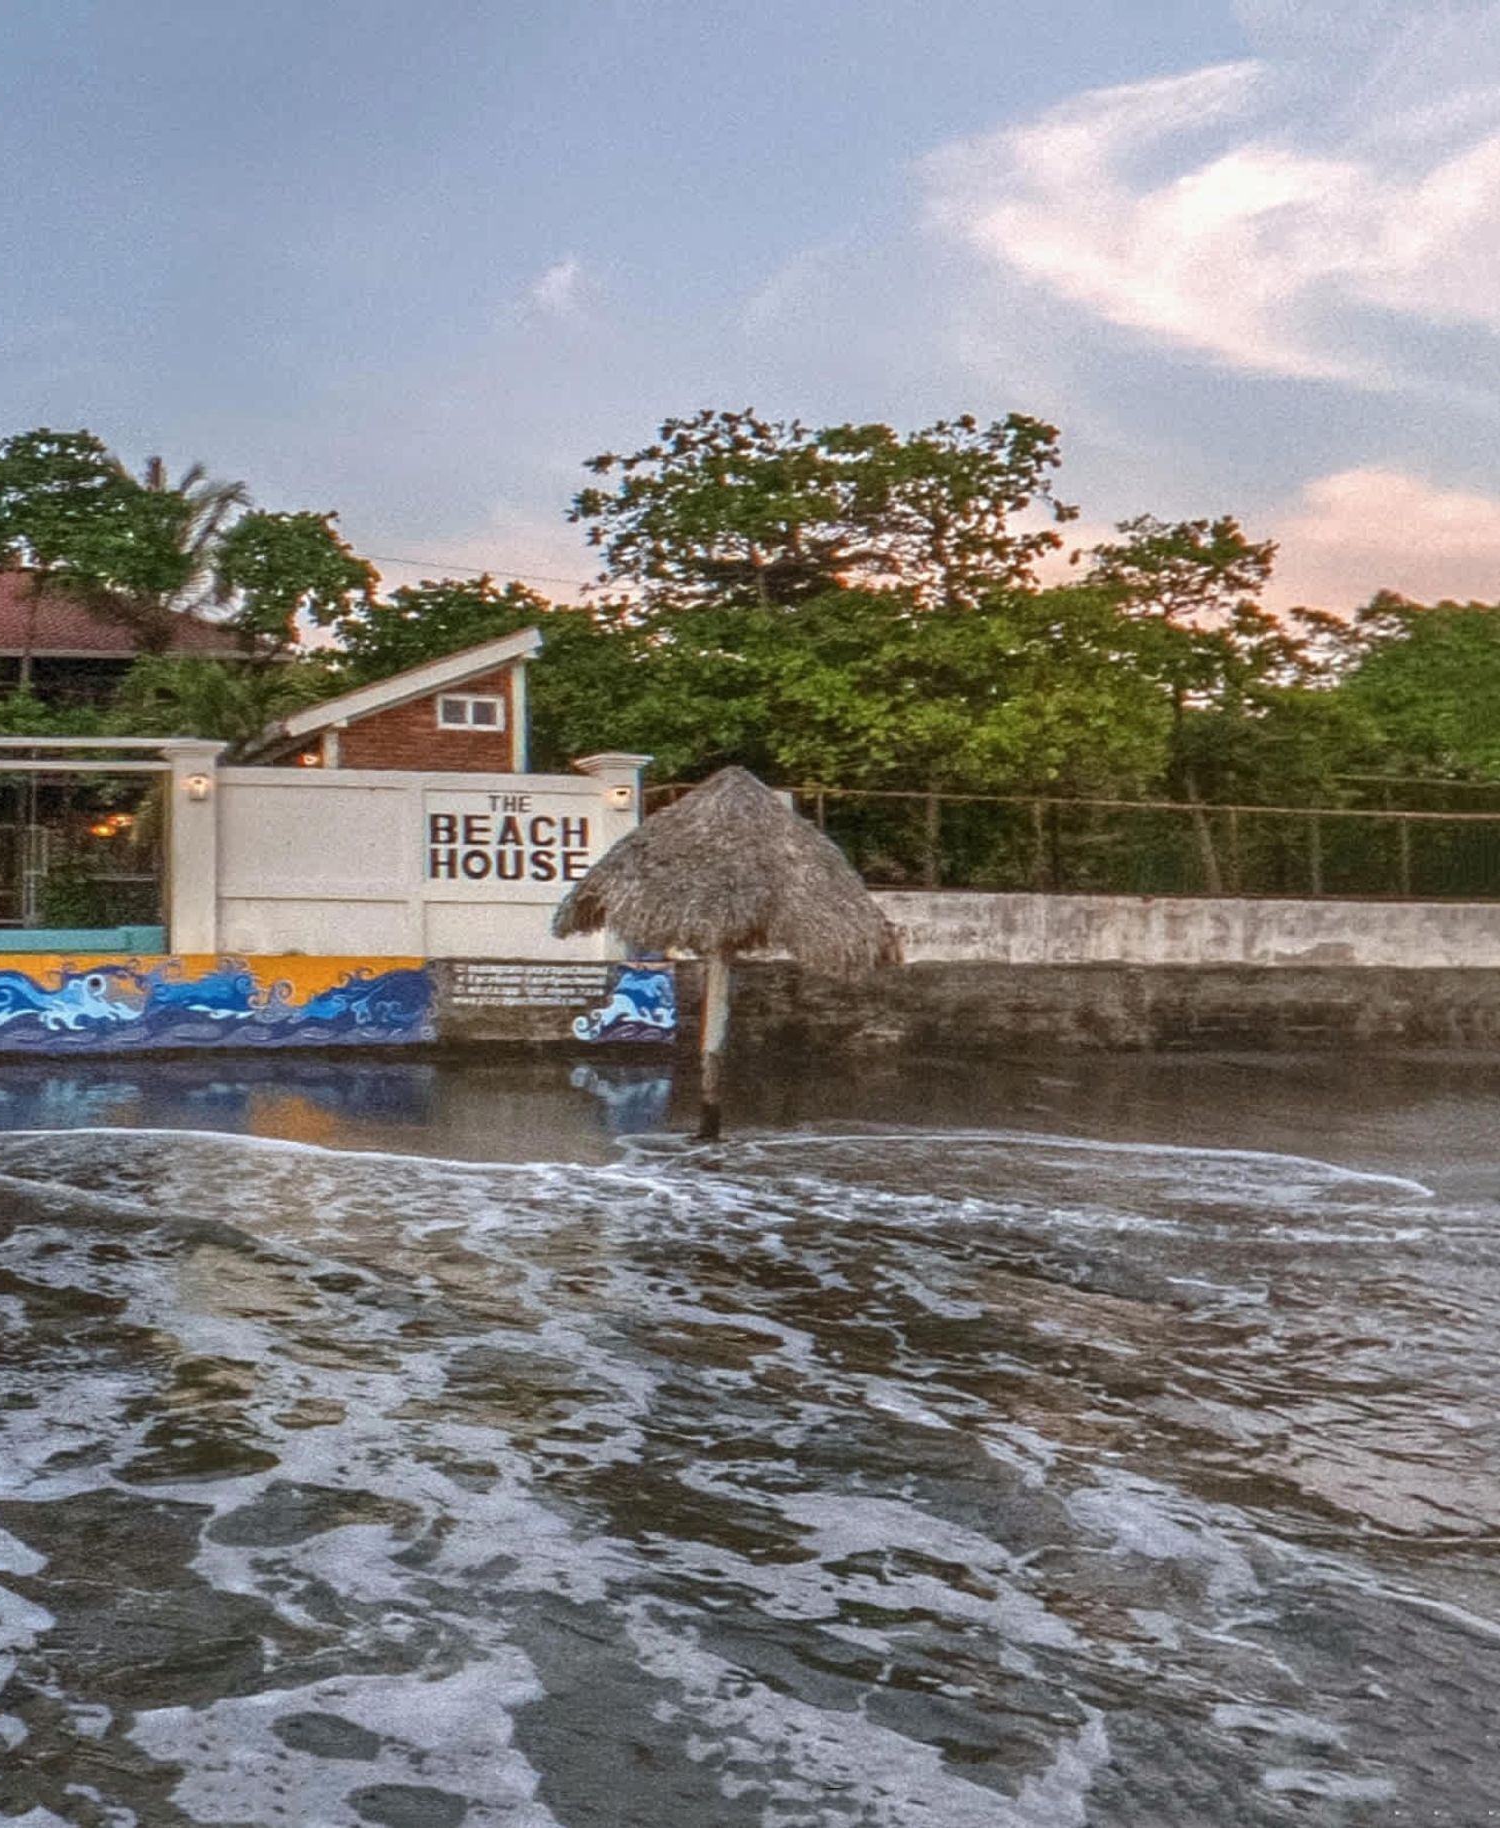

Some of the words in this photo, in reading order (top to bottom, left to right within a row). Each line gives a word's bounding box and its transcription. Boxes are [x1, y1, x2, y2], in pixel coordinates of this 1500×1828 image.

[488, 795, 532, 813] THE
[430, 813, 589, 847] BEACH
[430, 848, 590, 881] HOUSE
